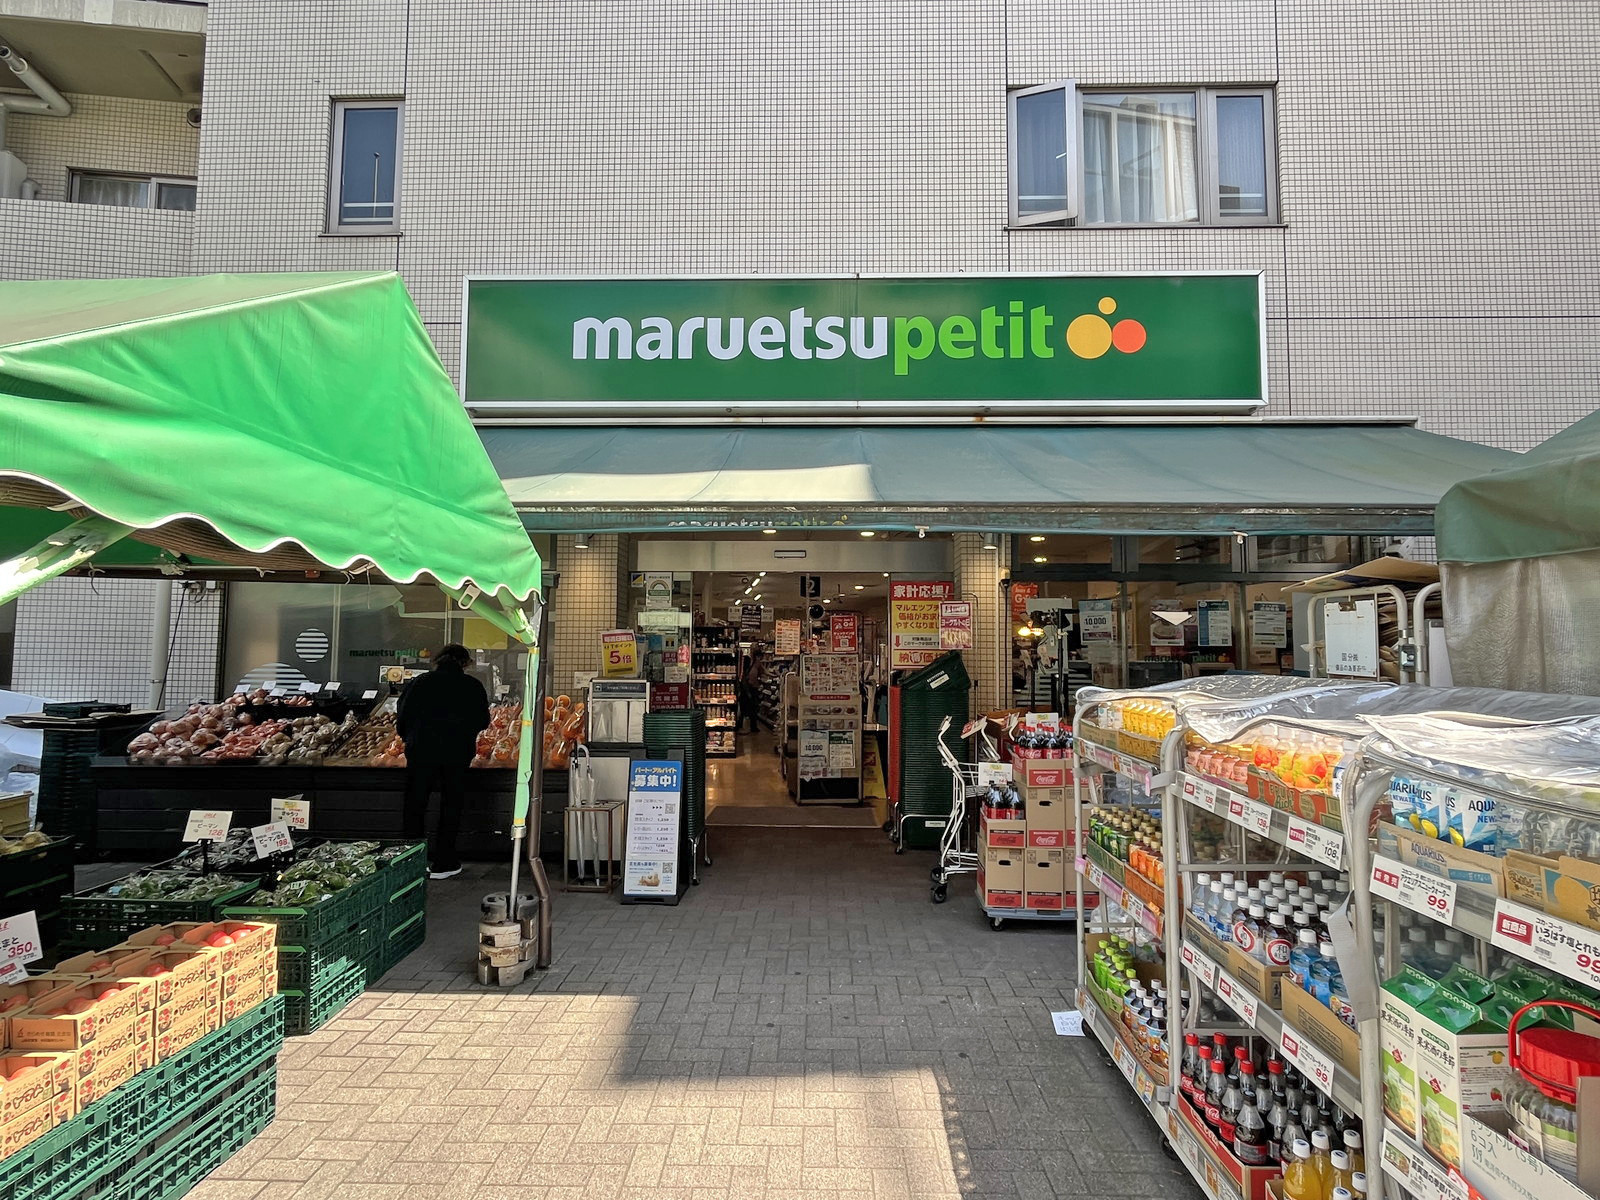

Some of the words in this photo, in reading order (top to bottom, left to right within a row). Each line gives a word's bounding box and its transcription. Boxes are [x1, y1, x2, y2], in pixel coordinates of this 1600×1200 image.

[893, 584, 950, 598] 家計応援!
[898, 612, 940, 621] 価格がお求
[634, 774, 677, 788] 募集中!
[1323, 845, 1338, 859] 108
[1411, 842, 1445, 863] AQUARIUS
[0, 937, 20, 949] まと
[1315, 1067, 1328, 1082] 99
